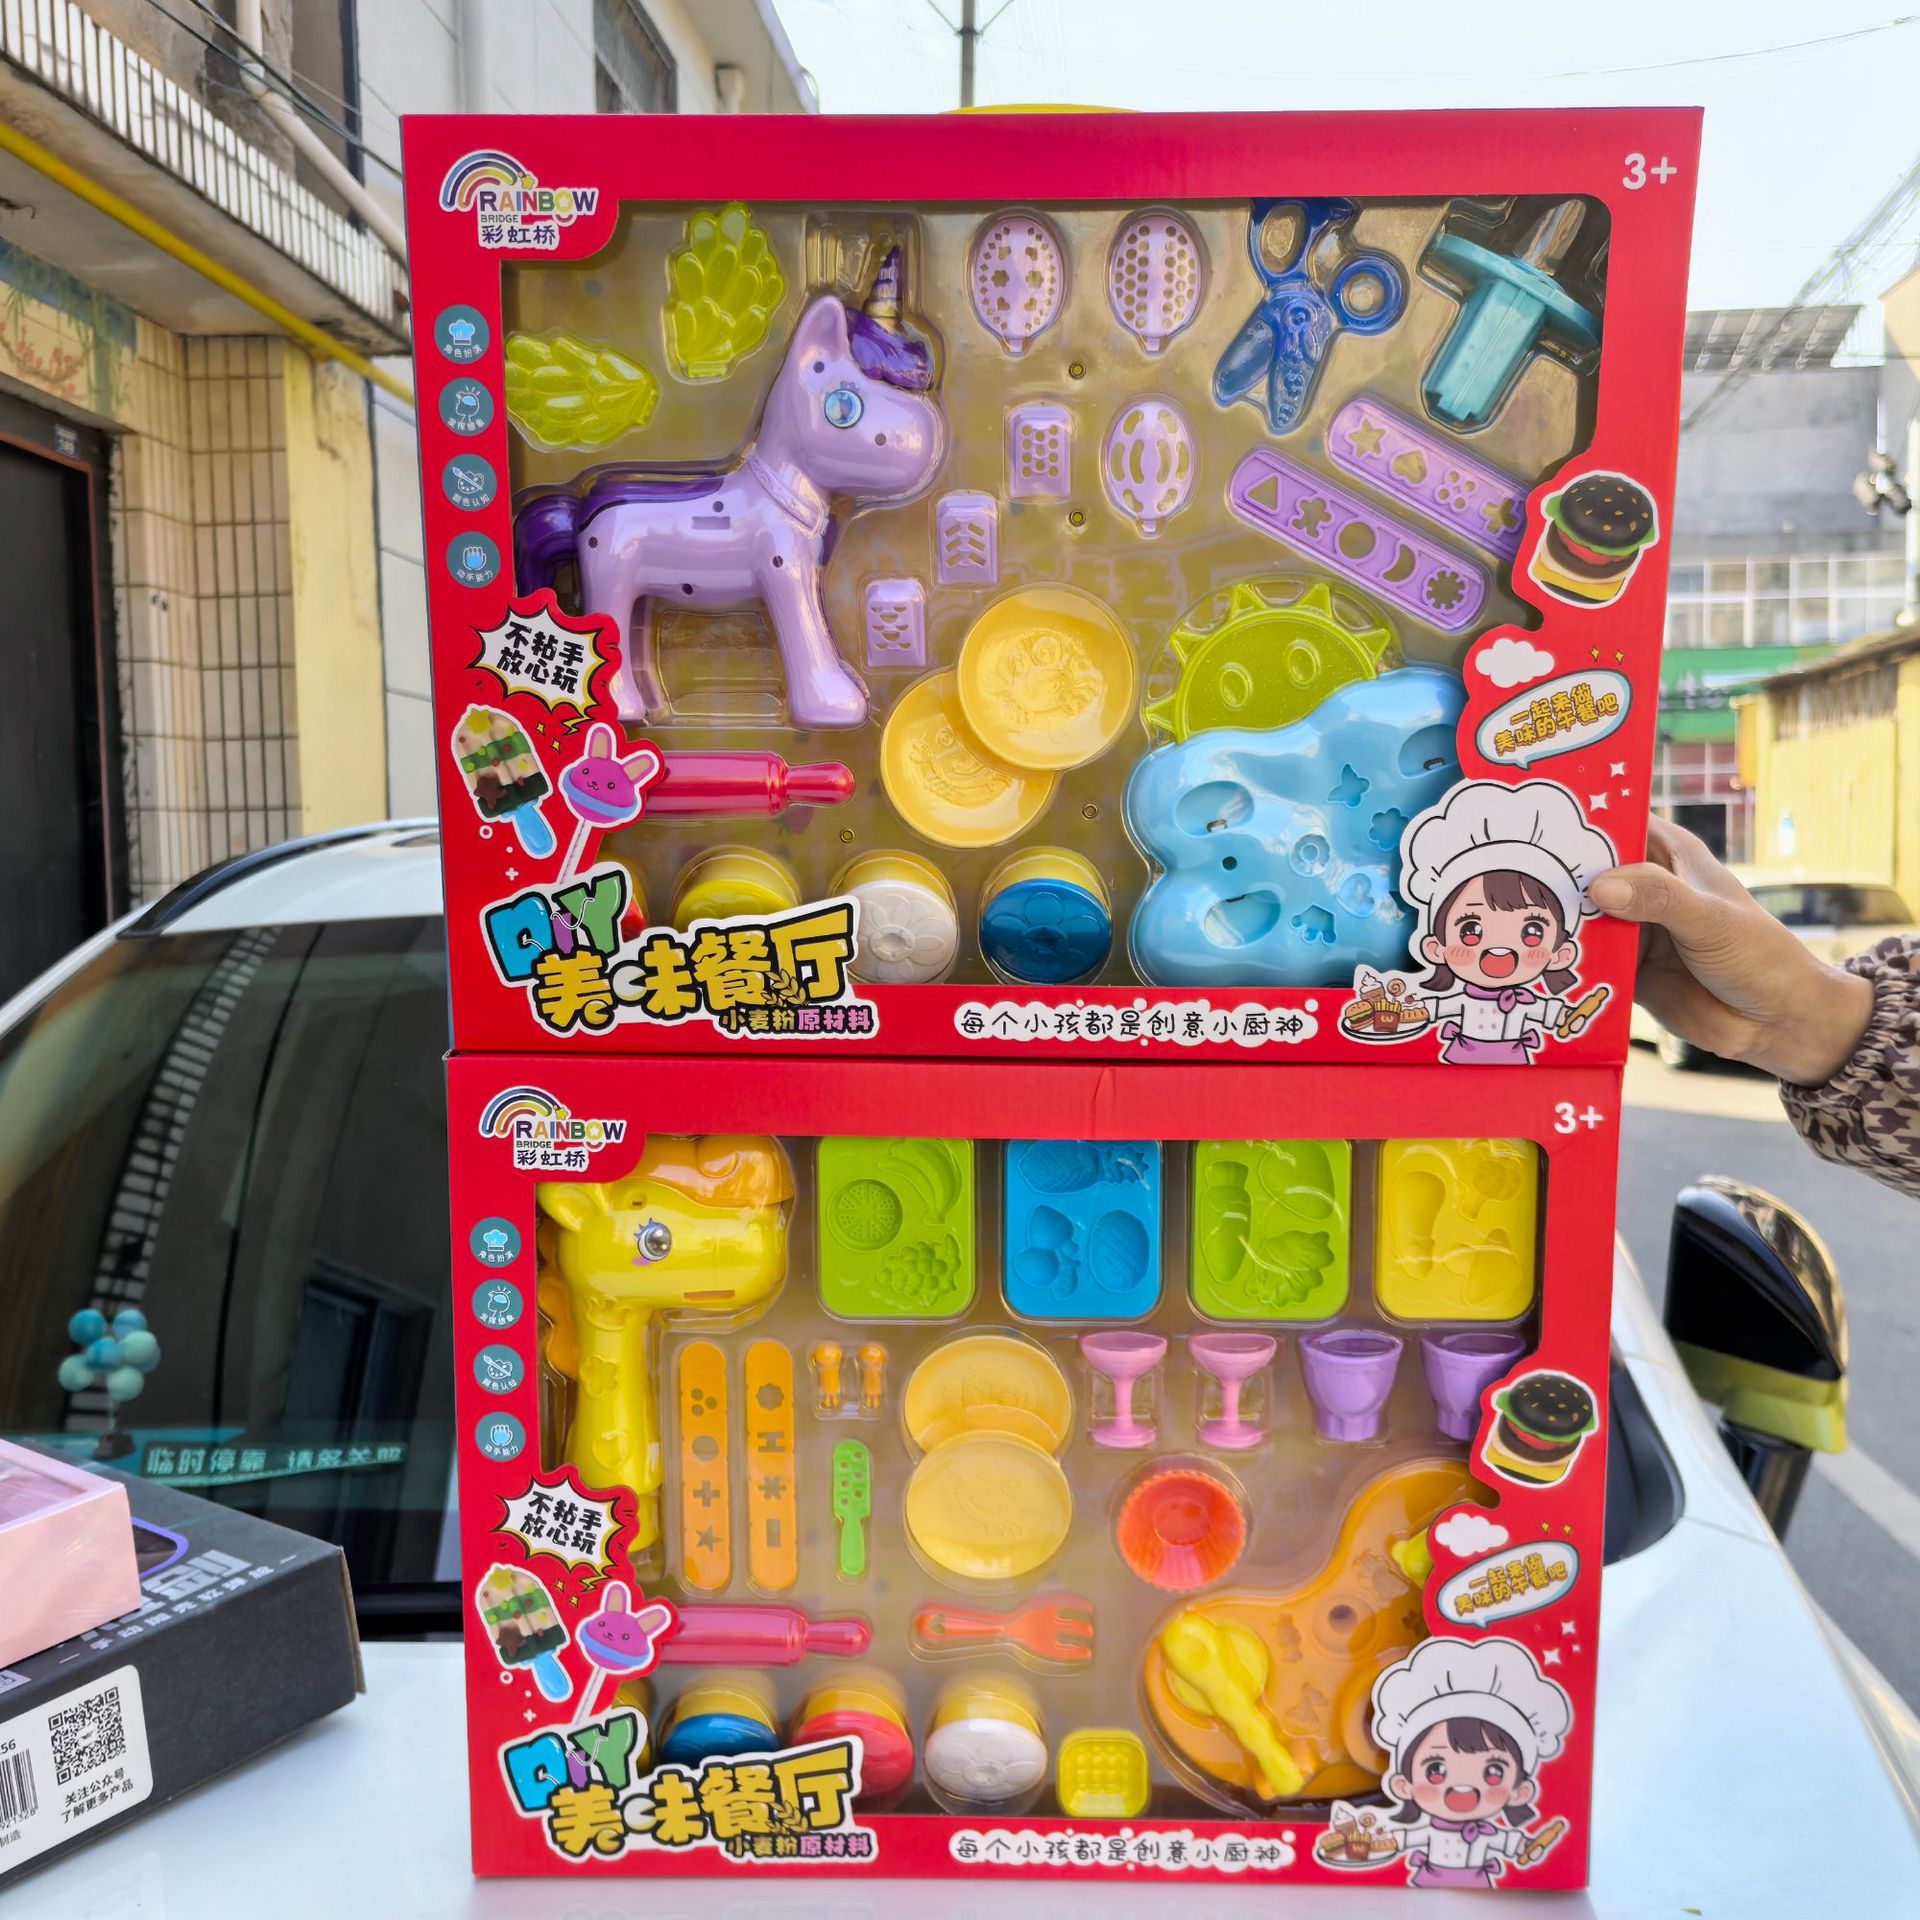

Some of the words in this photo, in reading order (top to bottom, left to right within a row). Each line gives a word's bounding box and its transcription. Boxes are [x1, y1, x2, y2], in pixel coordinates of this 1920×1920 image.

[1622, 153, 1678, 190] 3+
[480, 190, 596, 212] RAINBOW
[481, 214, 519, 223] BRIDGE
[482, 225, 556, 245] 彩虹桥
[456, 568, 494, 582] 动手能力
[505, 621, 585, 667] 不粘手
[496, 647, 579, 694] 放心玩
[1510, 682, 1594, 725] 一起来做
[1494, 693, 1619, 756] 美味的午餐吧
[533, 903, 856, 1031] 美味餐厅
[721, 1006, 872, 1032] 小麦粉原材料
[960, 1009, 1305, 1038] 每个小孩都是创意小厨神
[516, 1120, 624, 1141] RAINBOW
[1553, 1102, 1604, 1134] 3+
[516, 1141, 552, 1149] BRIDGE
[517, 1149, 586, 1168] 彩虹桥
[147, 1447, 267, 1475] 临时停靠
[528, 1491, 603, 1531] 不粘手
[520, 1513, 597, 1555] 放心玩
[1469, 1552, 1545, 1589] 一起来做
[1454, 1561, 1568, 1616] 美味的午餐吧
[61, 1778, 134, 1824] 了解更多产品
[65, 1768, 125, 1808] 关注公众号
[547, 1741, 853, 1856] 美味餐厅
[726, 1833, 873, 1858] 小麦粉原材料
[955, 1836, 1281, 1864] 每个小孩都是创意小厨神
